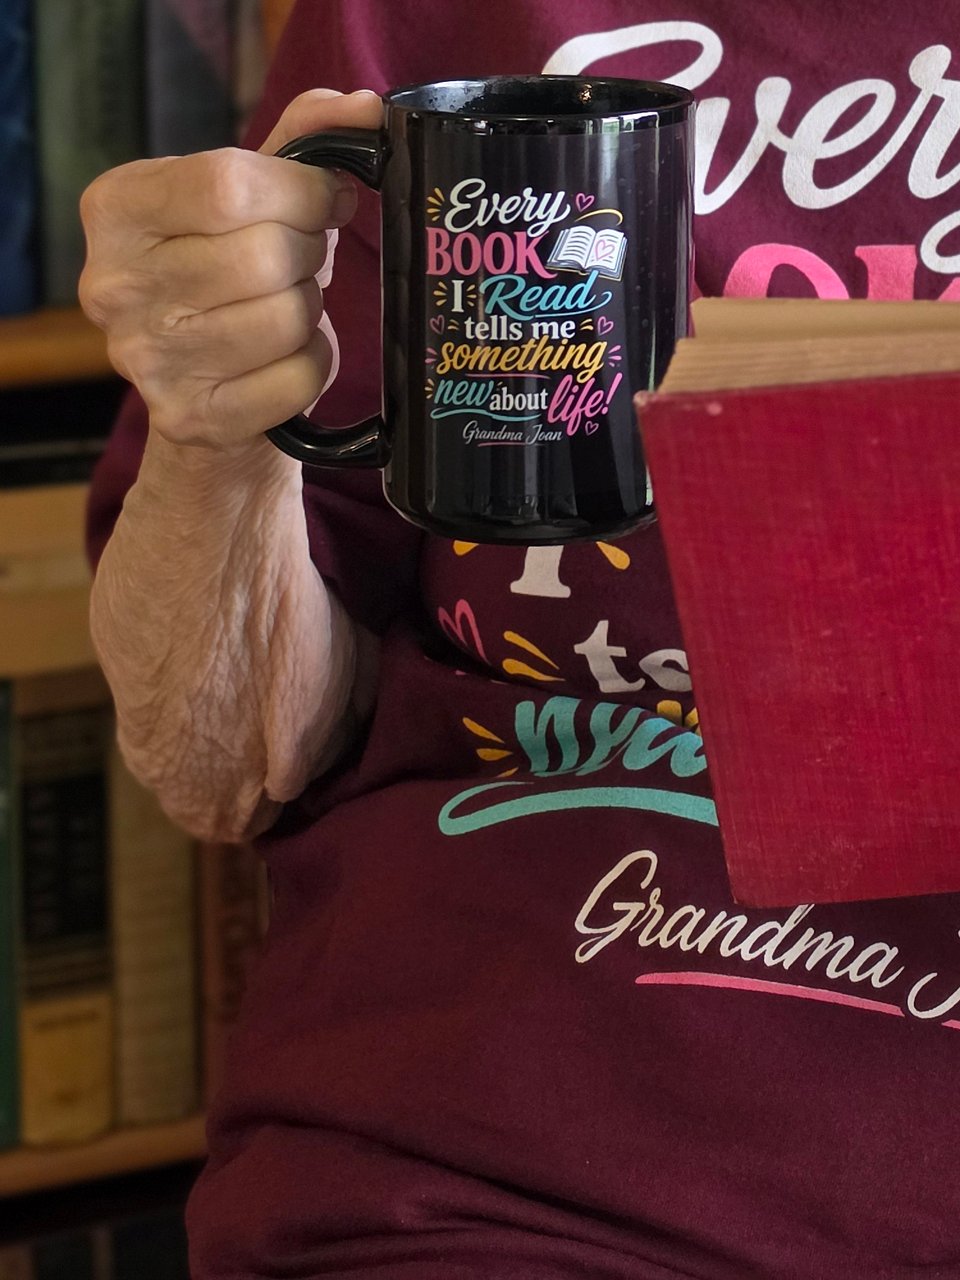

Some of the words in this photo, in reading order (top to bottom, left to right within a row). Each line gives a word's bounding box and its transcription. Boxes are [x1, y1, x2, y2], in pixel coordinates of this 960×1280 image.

[444, 178, 571, 238] Every
[425, 227, 557, 279] BOOK
[450, 279, 466, 313] I
[479, 271, 613, 321] Read
[464, 316, 525, 341] tells
[532, 320, 576, 340] me
[436, 335, 607, 384] something
[434, 378, 494, 405] new
[489, 385, 549, 412] about
[547, 372, 622, 437] life!
[462, 421, 524, 443] Grandma
[525, 423, 564, 444] Joan
[574, 849, 907, 987] Grandma
